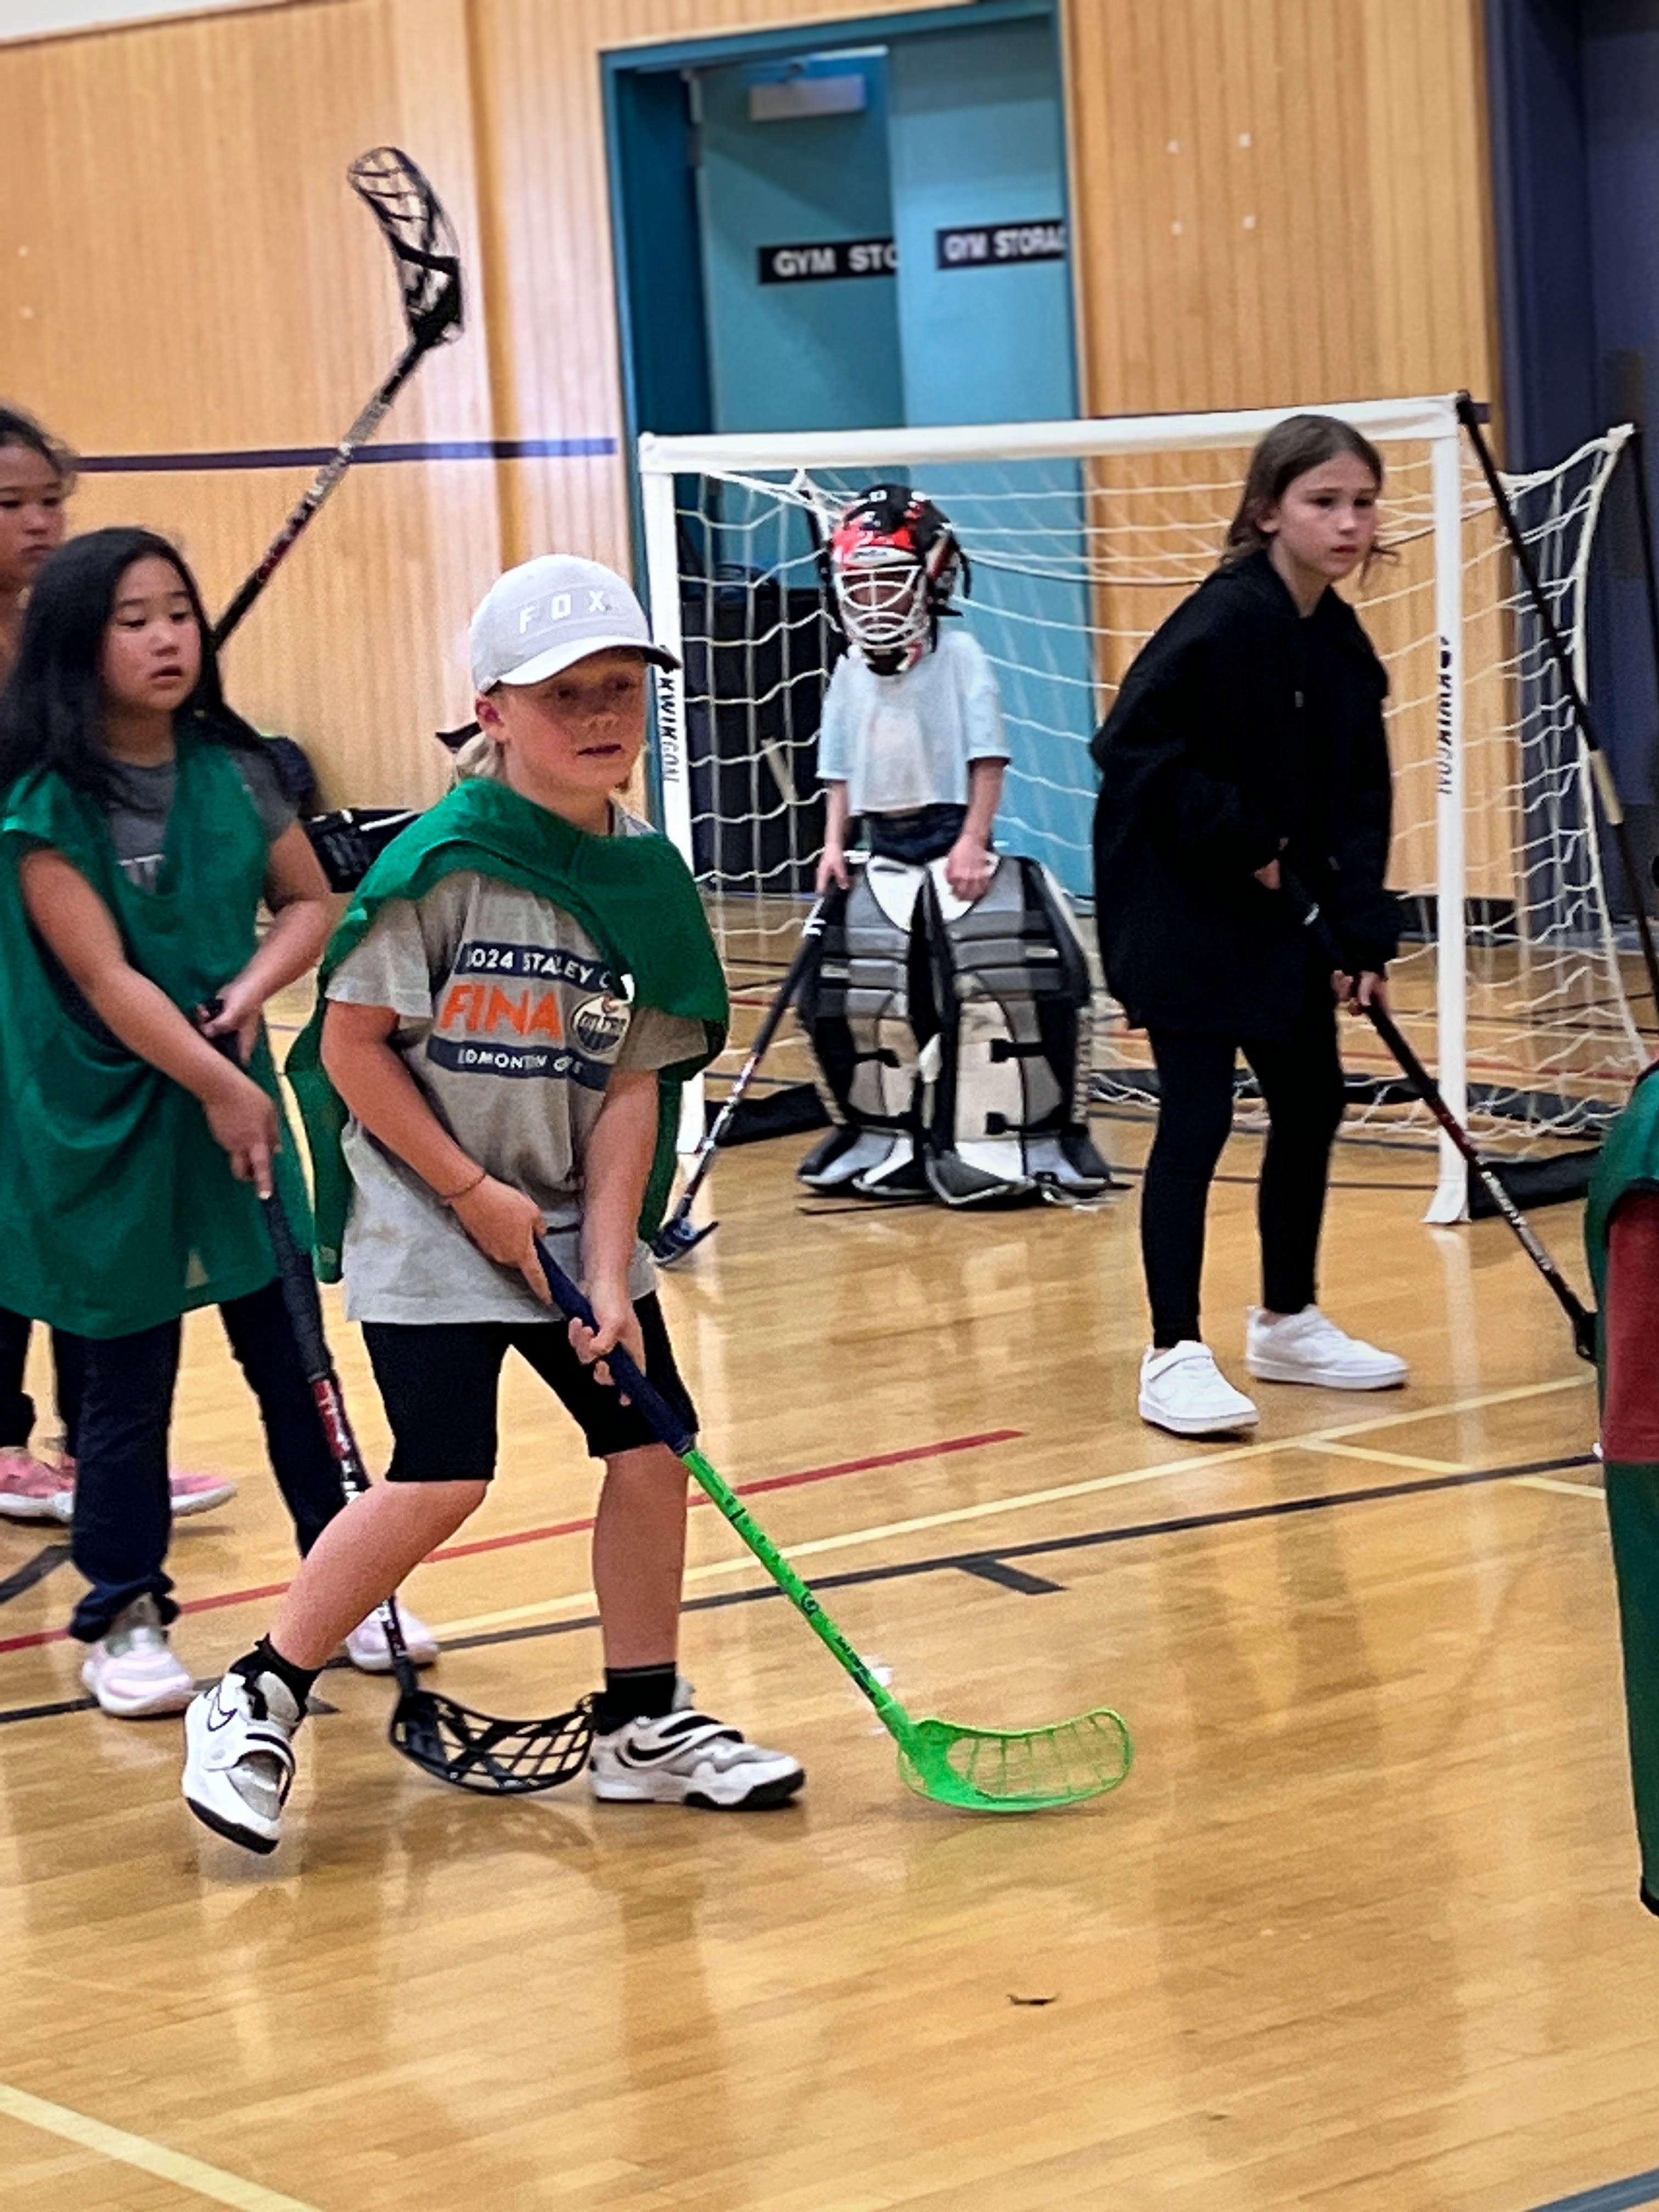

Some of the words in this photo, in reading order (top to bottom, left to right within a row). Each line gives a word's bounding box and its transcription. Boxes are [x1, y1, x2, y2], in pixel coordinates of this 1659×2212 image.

[772, 247, 837, 276] GYM
[944, 231, 988, 262] GYM
[520, 590, 606, 634] FOX
